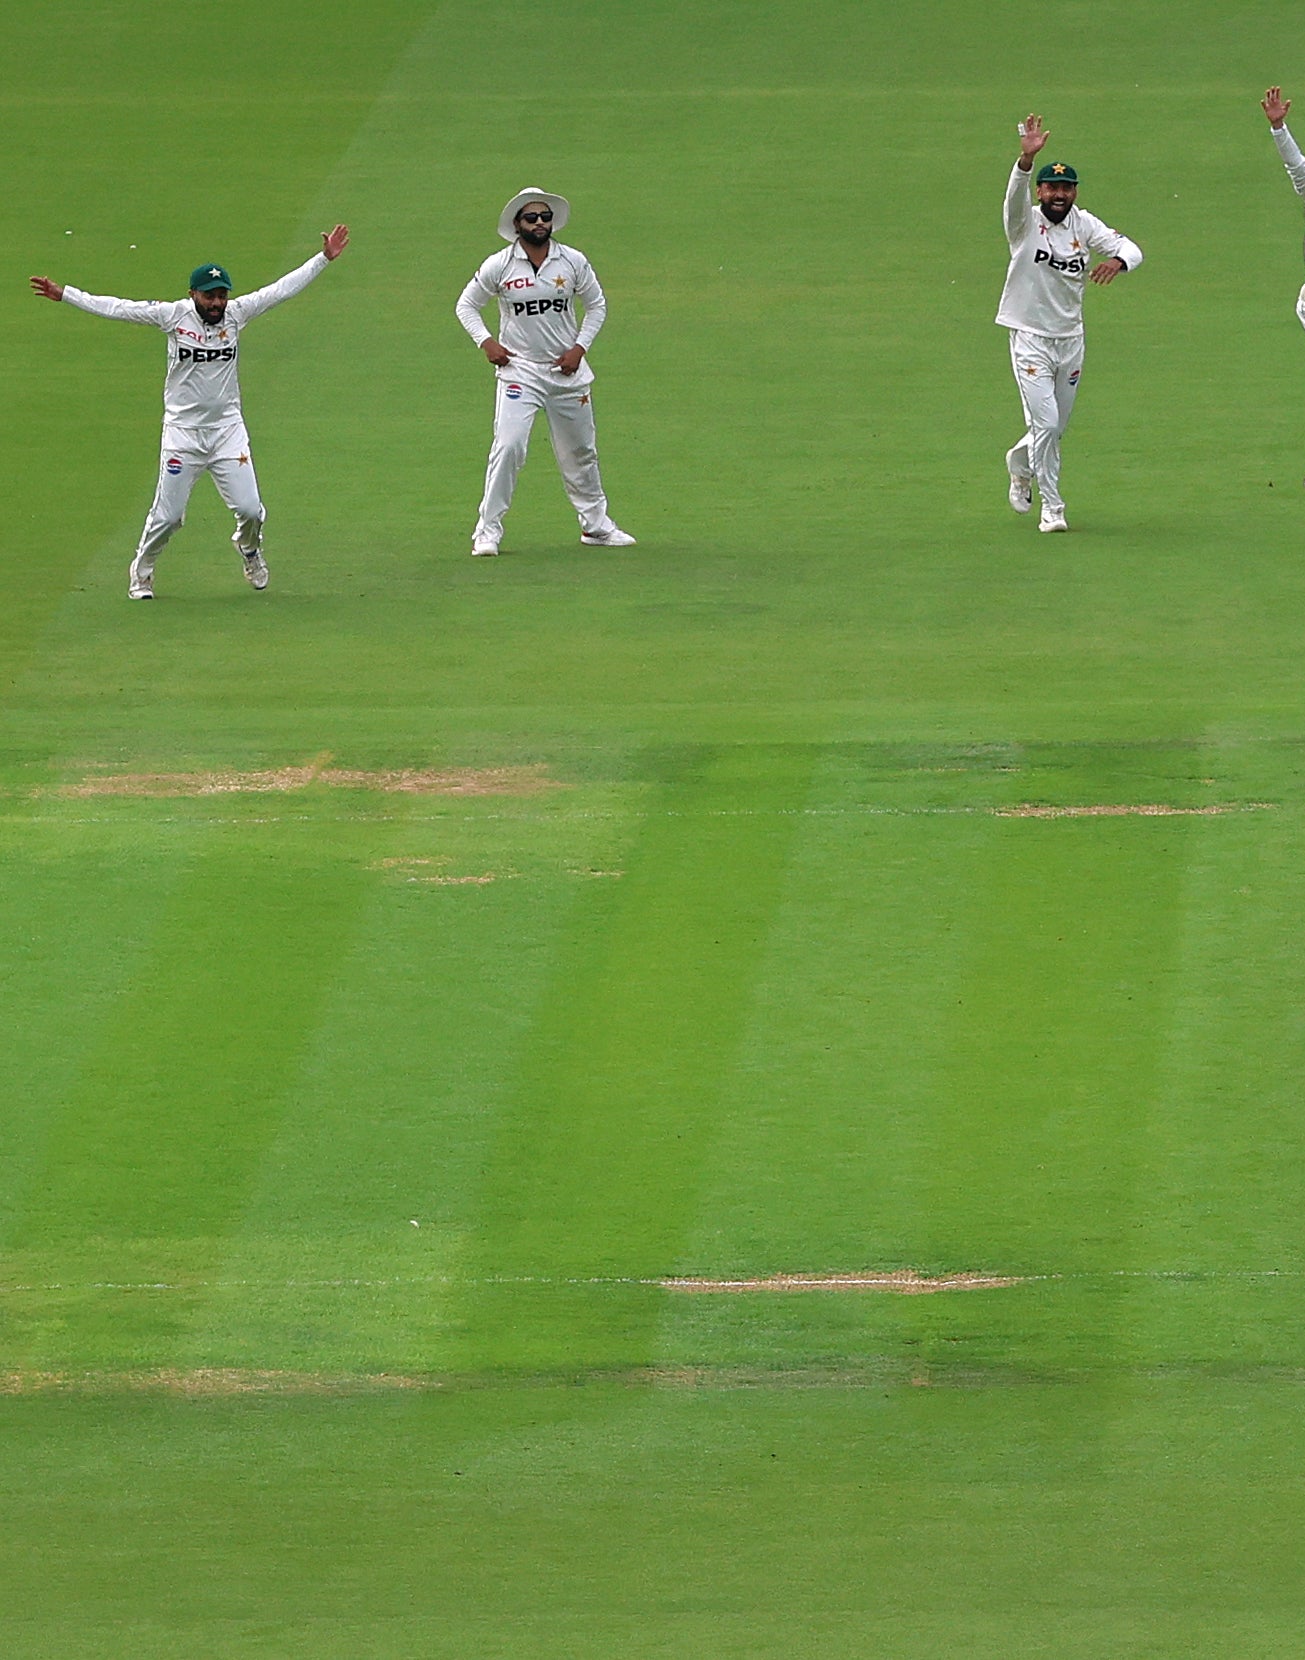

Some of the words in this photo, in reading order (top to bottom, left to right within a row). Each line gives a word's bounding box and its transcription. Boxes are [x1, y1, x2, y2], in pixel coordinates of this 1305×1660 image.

[505, 277, 535, 291] TCL
[513, 298, 569, 316] PEPSI
[179, 346, 237, 363] PEPSI
